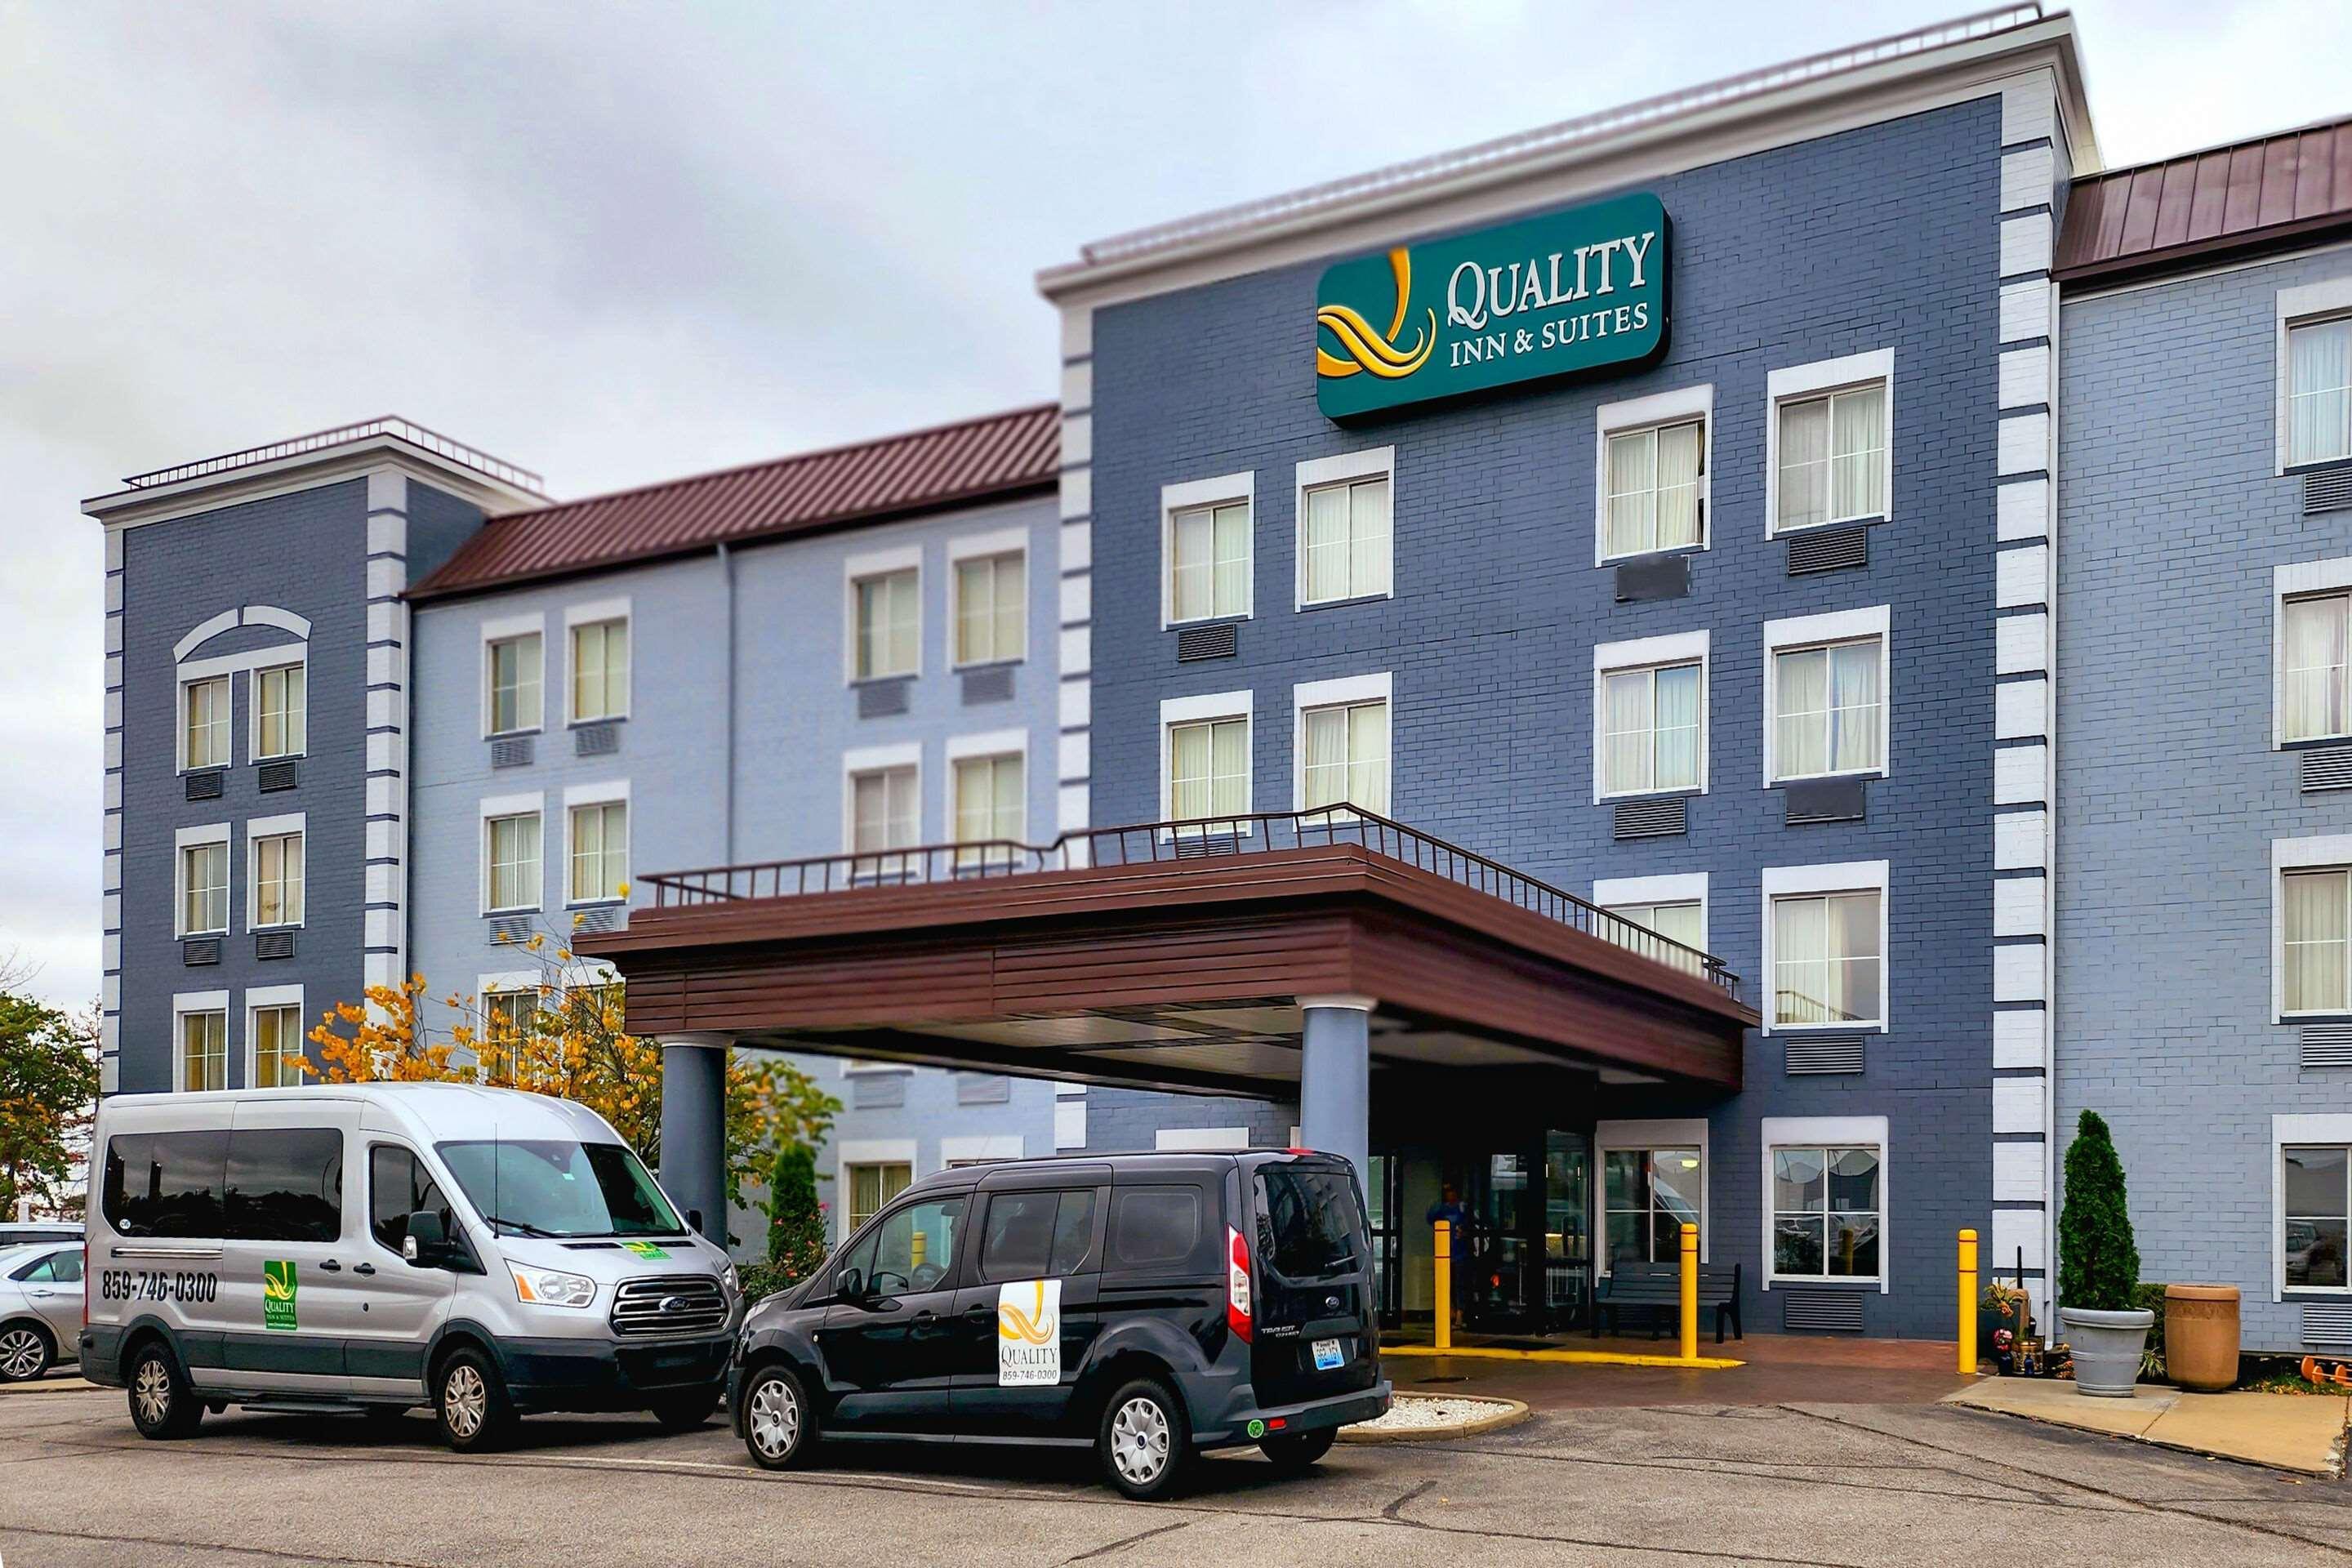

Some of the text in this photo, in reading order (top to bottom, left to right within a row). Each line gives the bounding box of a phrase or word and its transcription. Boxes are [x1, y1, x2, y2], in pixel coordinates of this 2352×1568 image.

[1447, 231, 1655, 331] QUALITY
[1450, 303, 1648, 368] INN & SUITES
[102, 1270, 218, 1303] 859-746-0300
[265, 1298, 295, 1314] QUALITY
[1001, 1345, 1057, 1367] QUALITY
[1002, 1370, 1057, 1380] 859-746-0300
